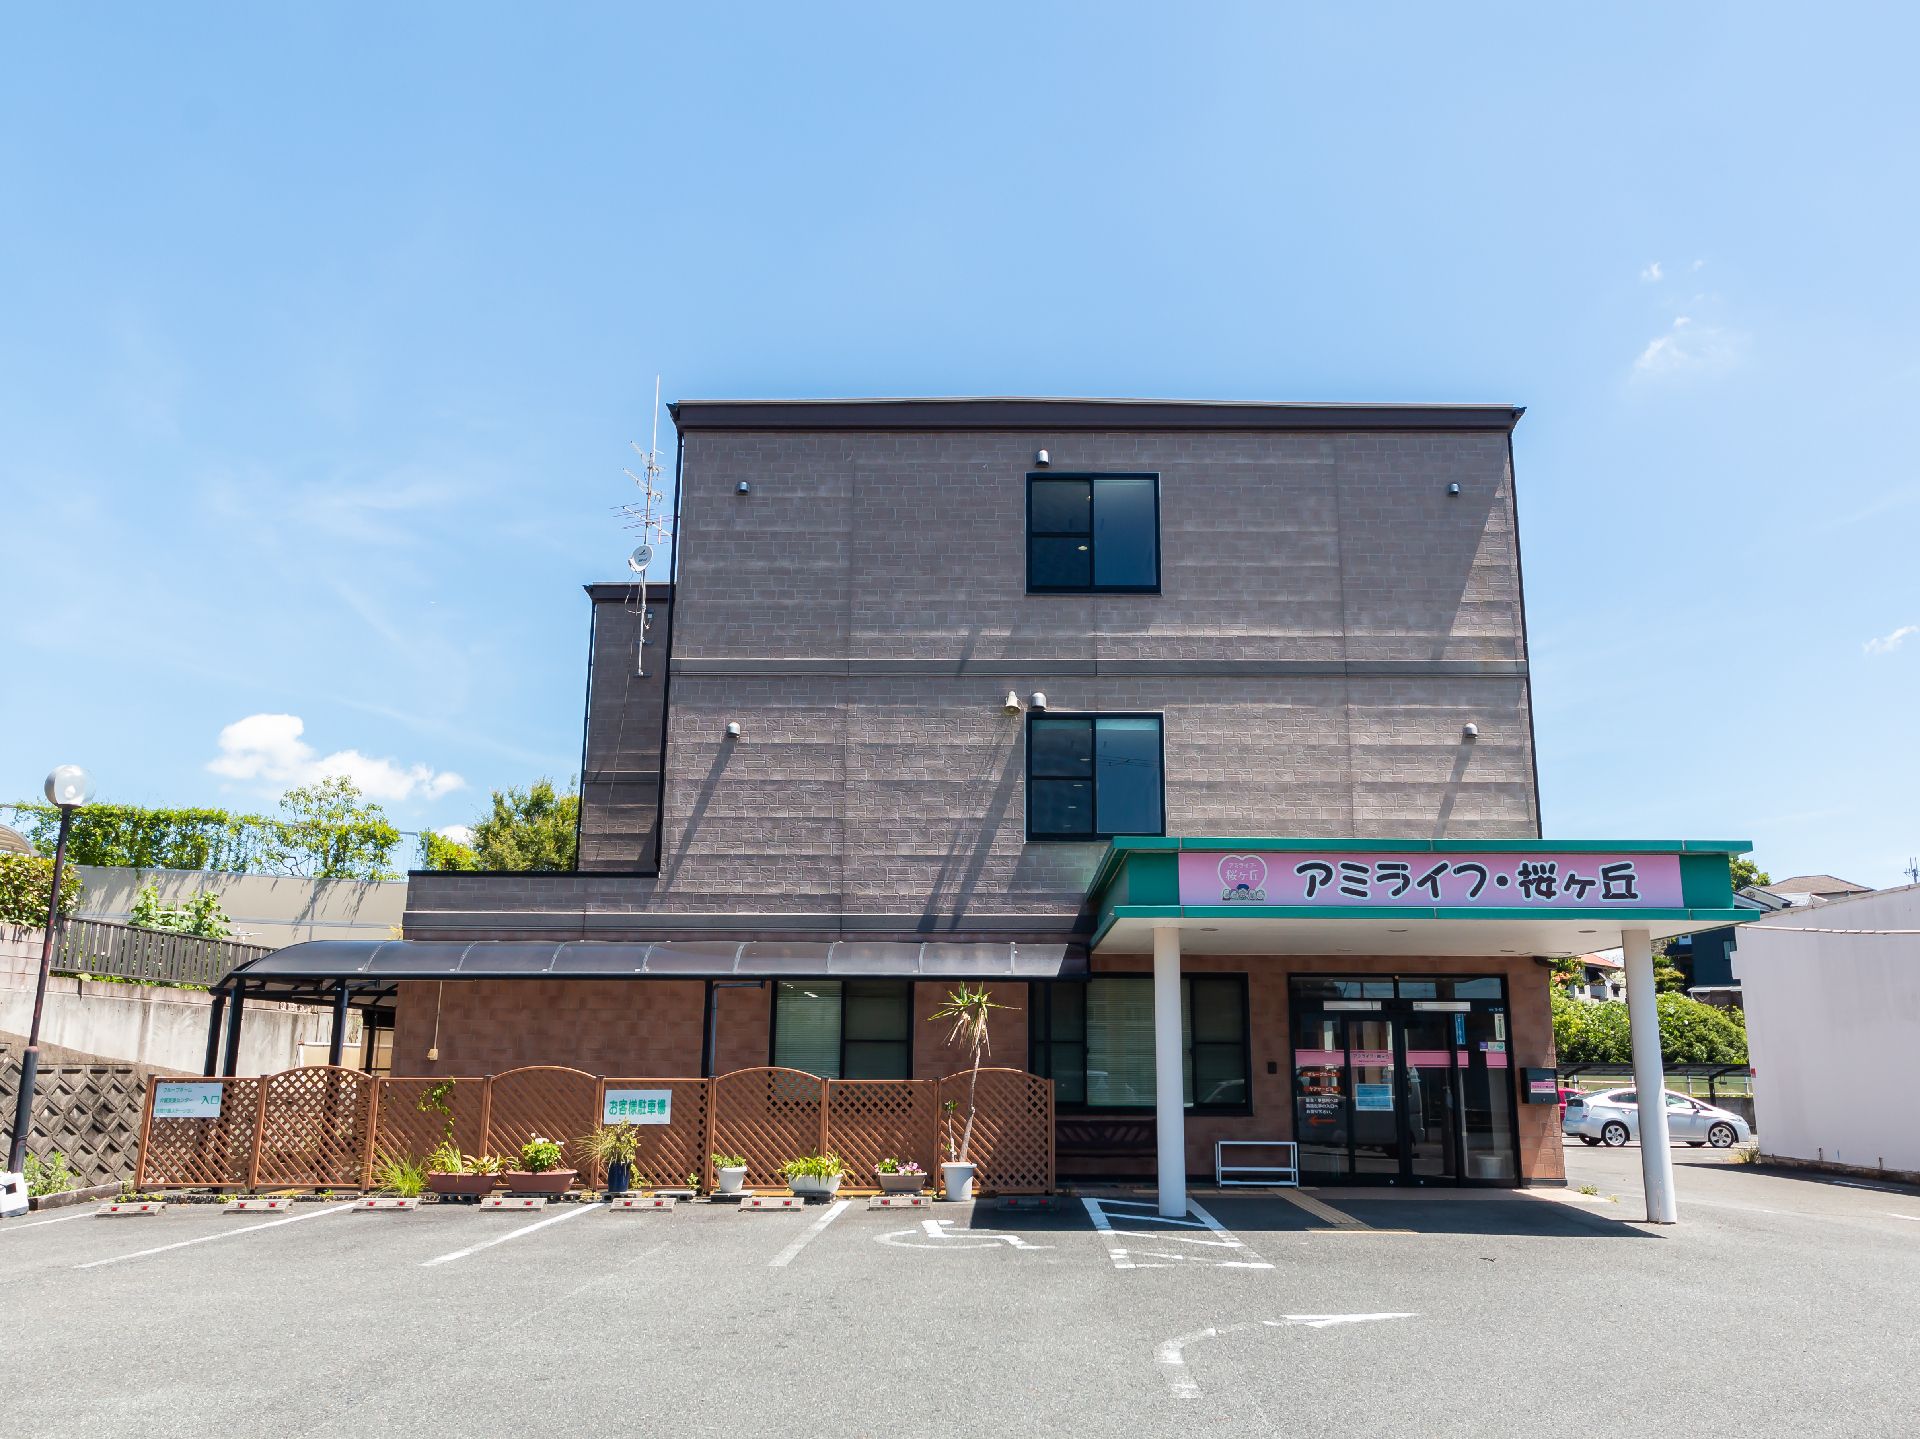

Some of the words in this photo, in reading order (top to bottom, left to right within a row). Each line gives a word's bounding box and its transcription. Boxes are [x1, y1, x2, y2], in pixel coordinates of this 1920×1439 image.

[1295, 861, 1640, 900] アミライフ・桜ヶ丘
[200, 1095, 220, 1105] 入口
[608, 1098, 666, 1116] お客様駐車場
